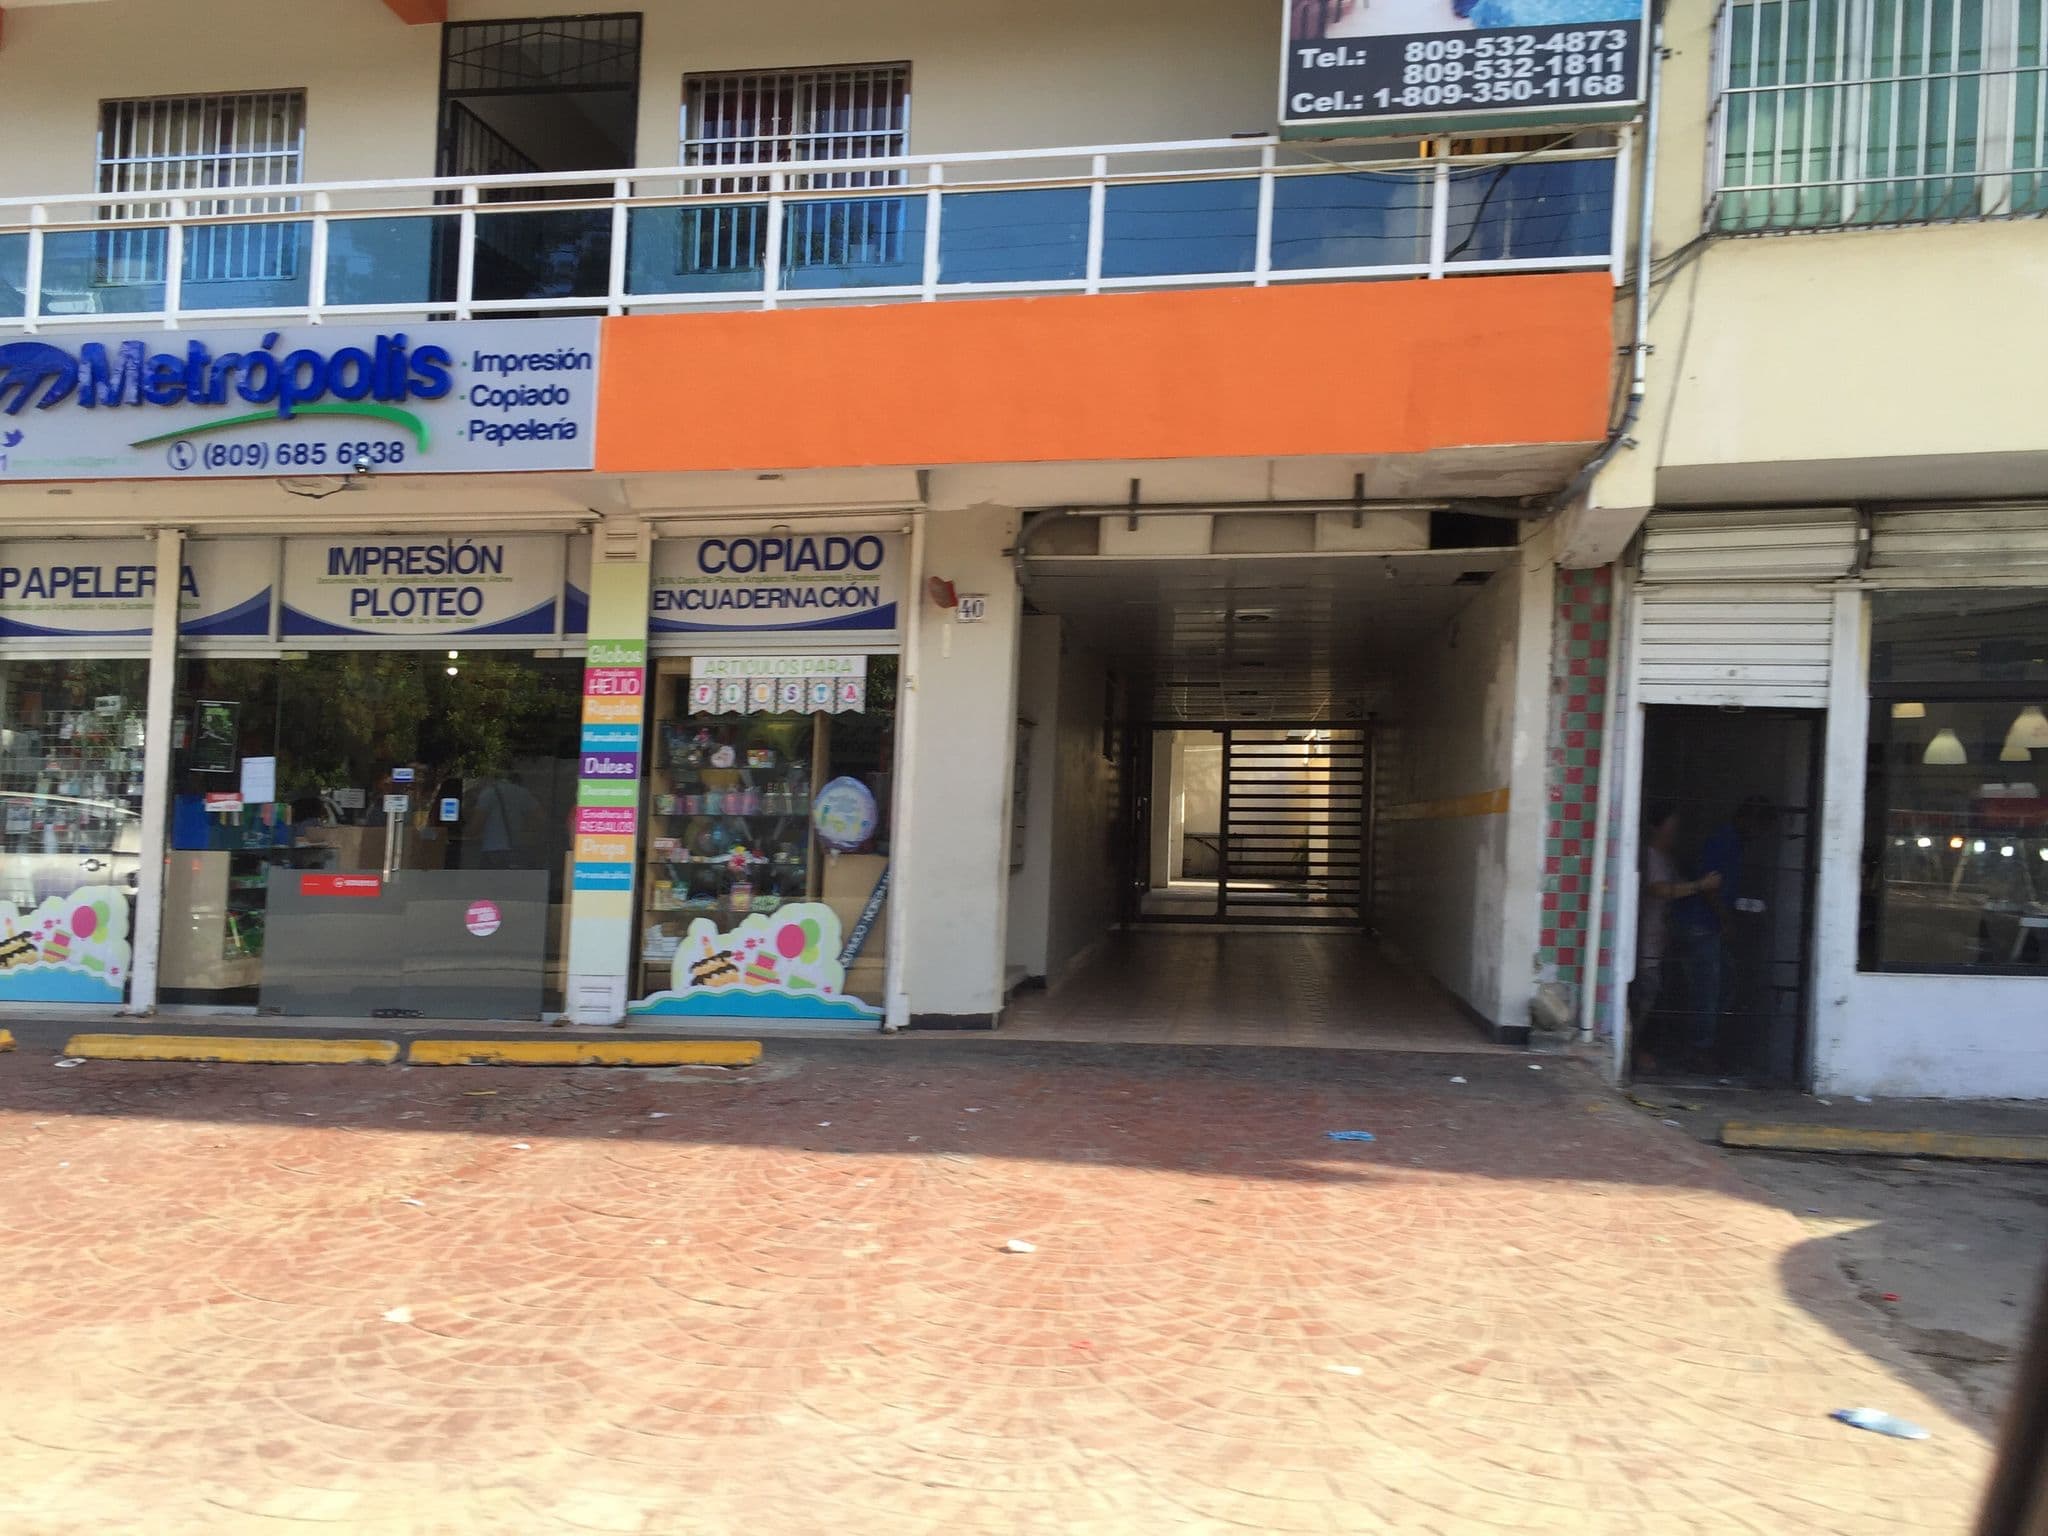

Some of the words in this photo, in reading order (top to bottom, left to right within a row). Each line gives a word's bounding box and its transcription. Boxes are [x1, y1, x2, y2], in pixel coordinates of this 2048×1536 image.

[1297, 46, 1367, 69] Tel.:
[1404, 29, 1628, 62] 809-532-4873
[1402, 52, 1625, 84] 809-532-1811
[1291, 91, 1364, 113] Cel.:
[1372, 74, 1626, 108] 1-809-350-1168
[78, 332, 453, 420] Metrópolis
[472, 348, 592, 377] Impresión
[470, 384, 570, 411] Copiado
[468, 417, 578, 446] Papelería
[204, 442, 269, 471] (809)
[276, 442, 327, 466] 685
[337, 440, 405, 464] 6838
[328, 538, 503, 576] IMPRESIÓN
[698, 535, 885, 574] COPIADO
[0, 565, 200, 600] PAPELERA
[653, 582, 880, 611] ENCUADERNACIÓN
[350, 586, 484, 617] PLOTEO
[590, 644, 641, 663] Globos
[803, 658, 853, 673] PARA
[589, 677, 640, 694] HELIO
[584, 757, 634, 774] Dulces
